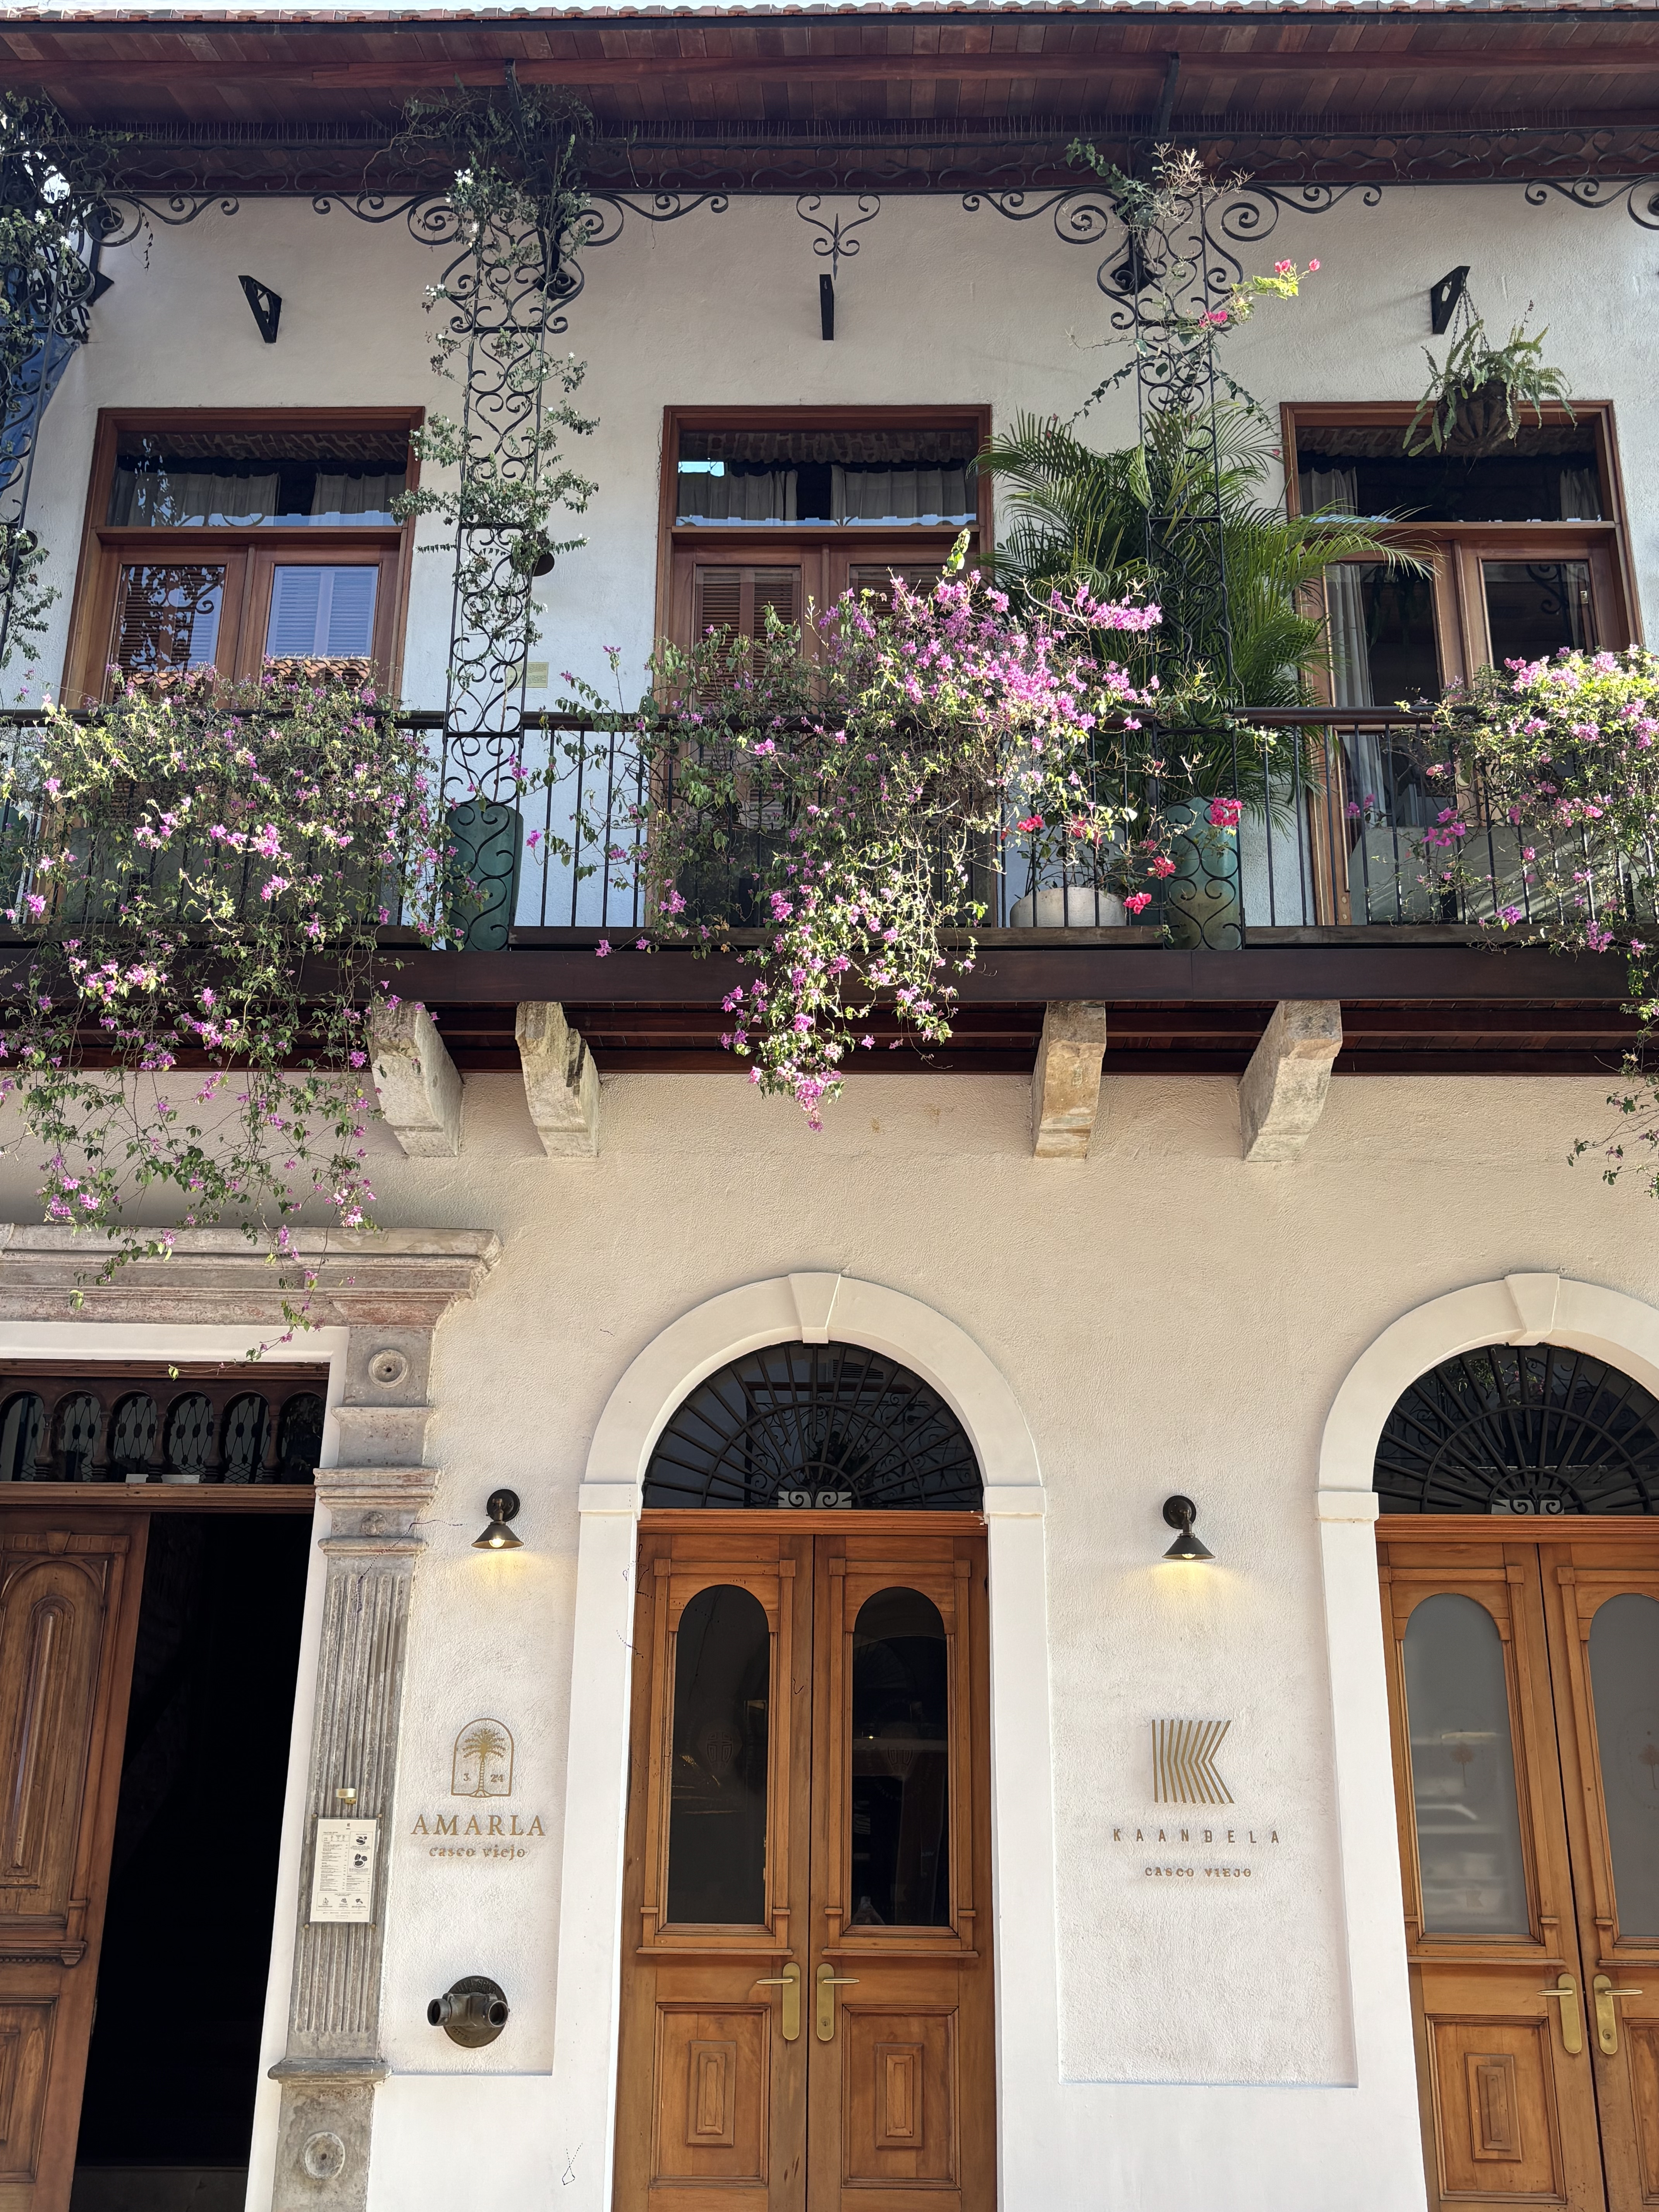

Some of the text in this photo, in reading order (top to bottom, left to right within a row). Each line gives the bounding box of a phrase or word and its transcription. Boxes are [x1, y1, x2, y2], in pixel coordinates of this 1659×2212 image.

[410, 1814, 546, 1836] AMARLA
[1113, 1829, 1279, 1844] KAANDELA
[429, 1844, 526, 1861] casco viejo
[1145, 1867, 1252, 1878] CASCO VIEJO
